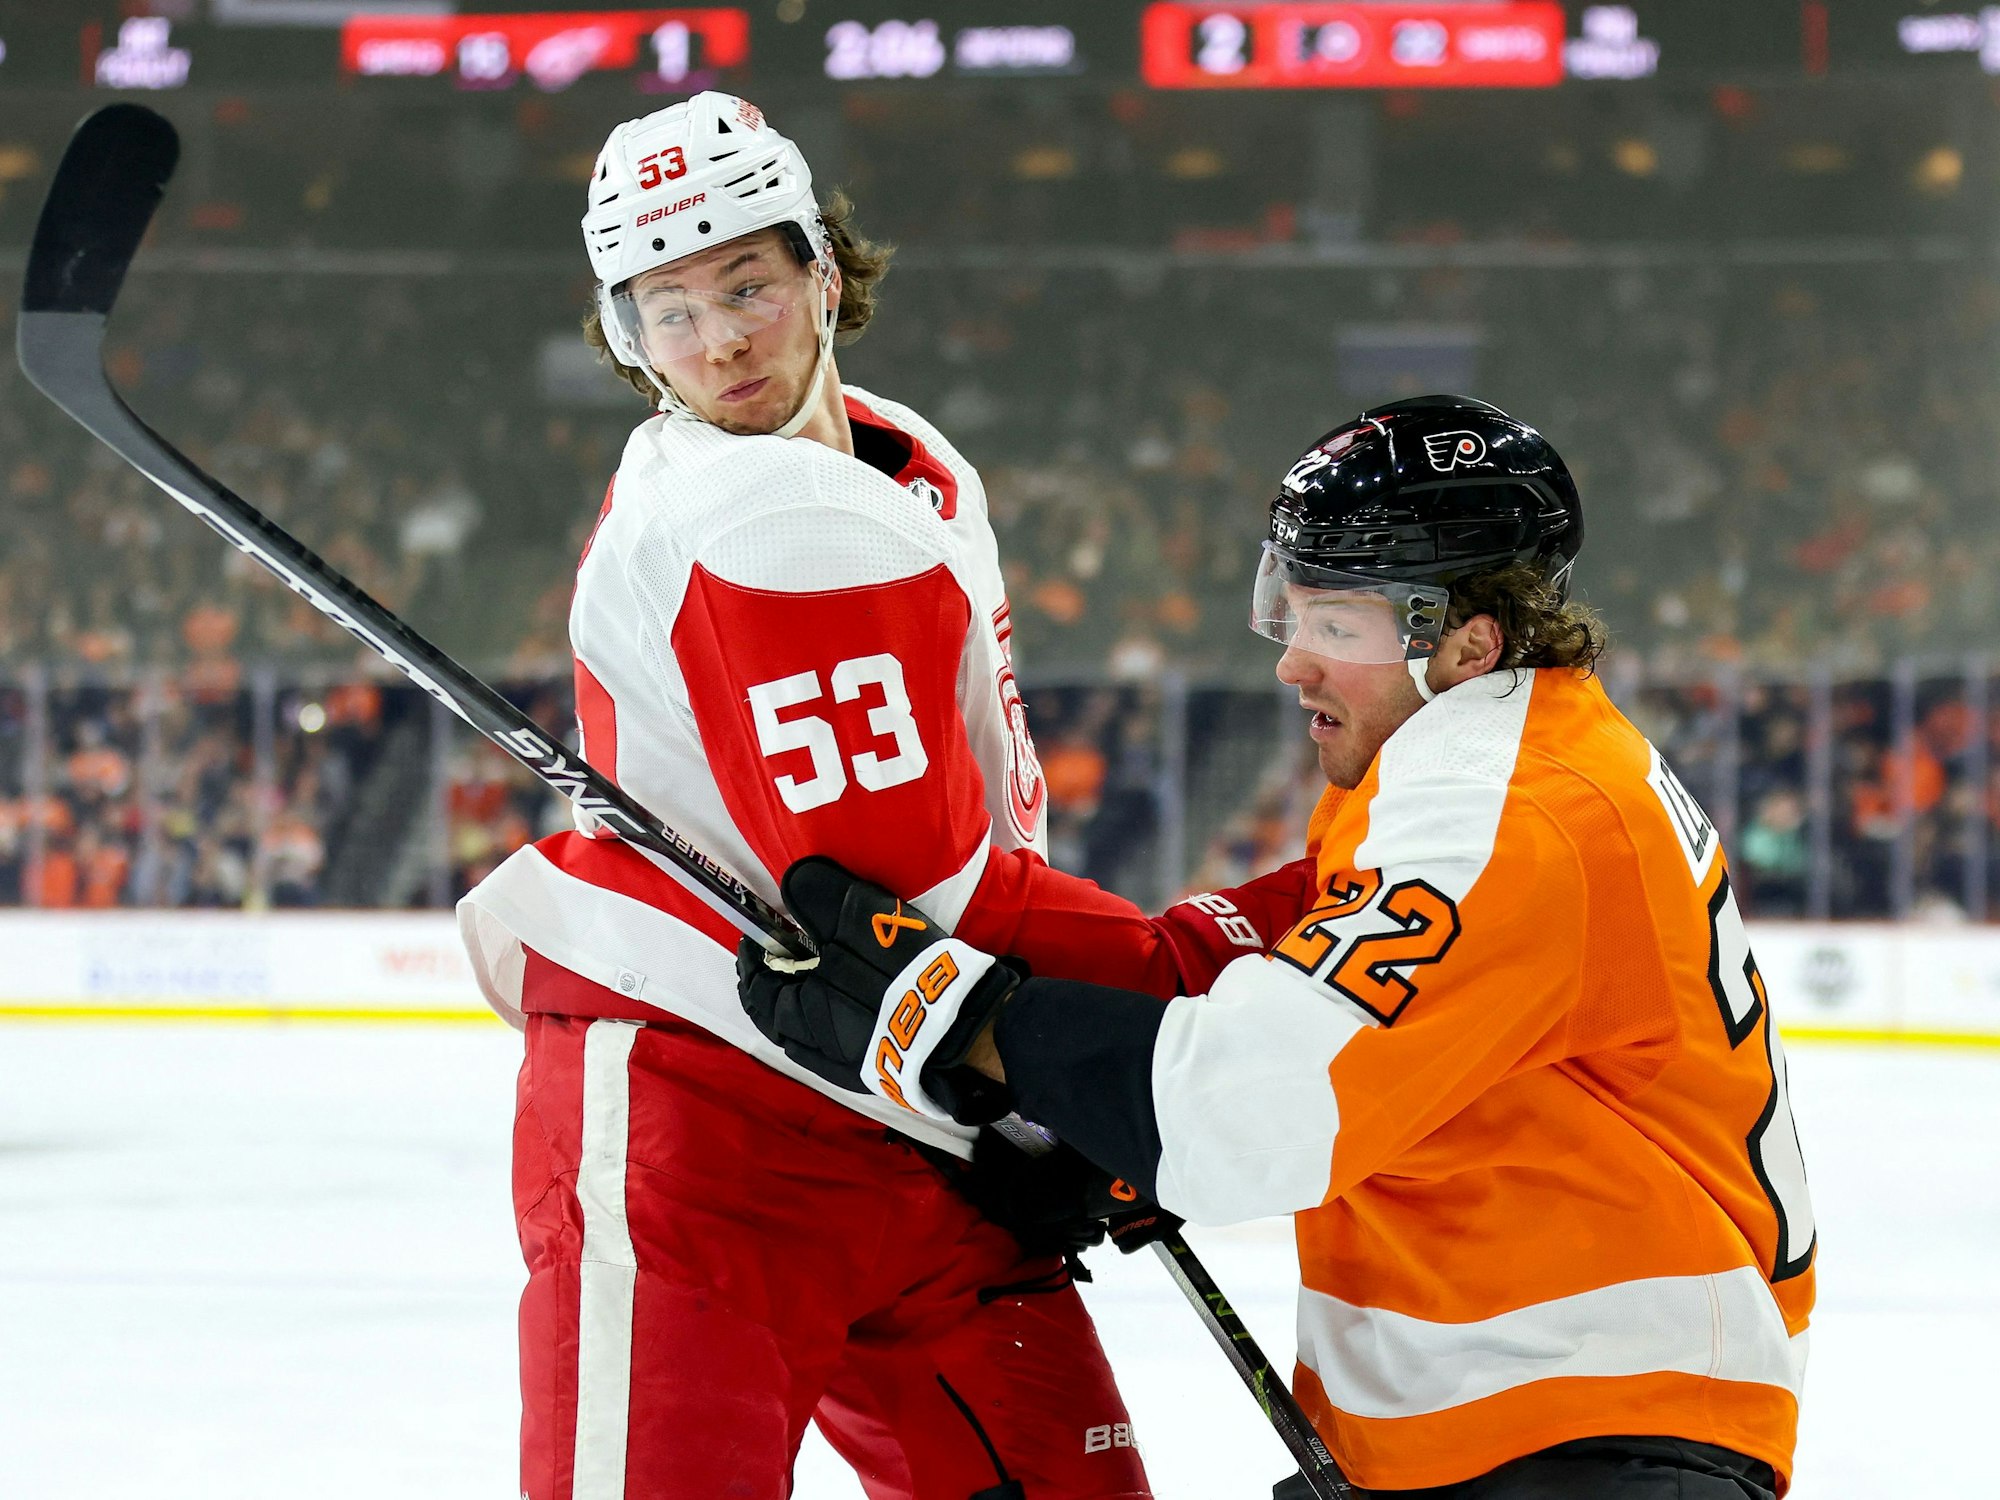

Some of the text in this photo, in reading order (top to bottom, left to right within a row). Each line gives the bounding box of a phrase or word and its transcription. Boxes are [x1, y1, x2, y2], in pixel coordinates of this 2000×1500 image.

[1199, 13, 1243, 75] 2
[638, 145, 687, 190] 53
[636, 192, 706, 228] BAUER
[1282, 449, 1332, 493] 22
[1272, 518, 1299, 543] CCM
[747, 652, 929, 815] 53
[493, 727, 647, 834] SYNC
[660, 823, 733, 887] BAUER
[1271, 866, 1462, 1028] 22
[1307, 1436, 1334, 1466] SEIDER
